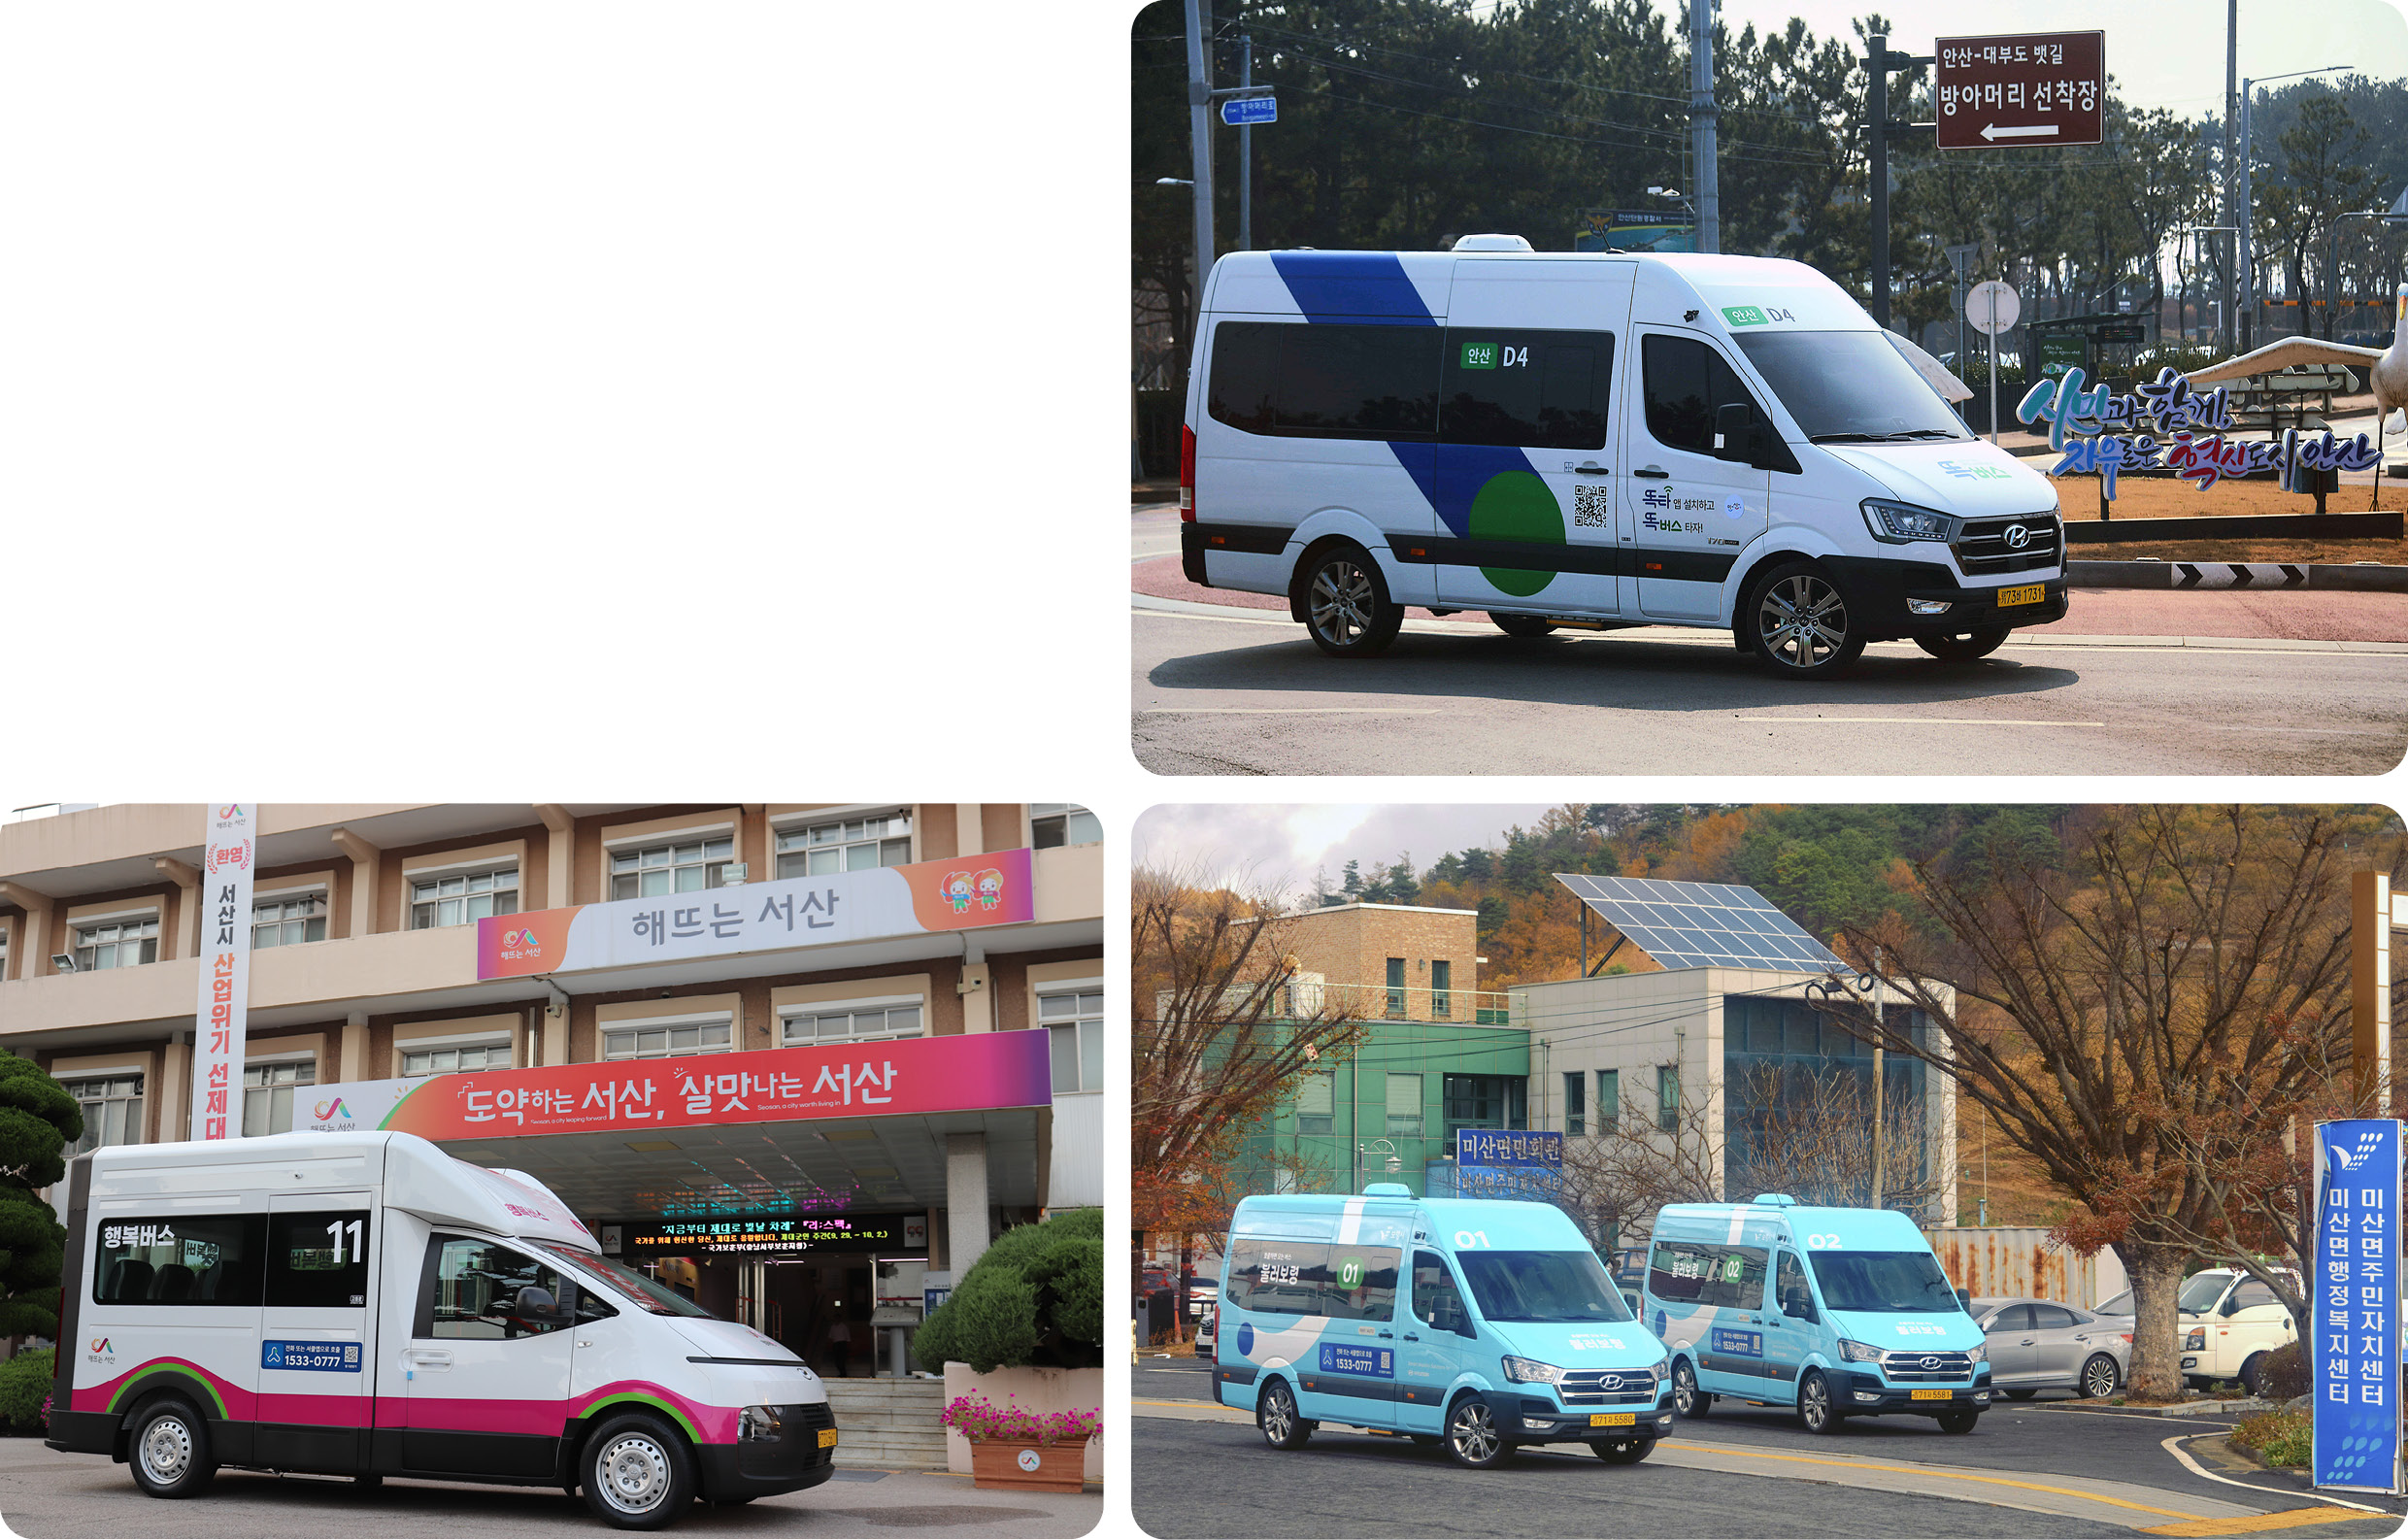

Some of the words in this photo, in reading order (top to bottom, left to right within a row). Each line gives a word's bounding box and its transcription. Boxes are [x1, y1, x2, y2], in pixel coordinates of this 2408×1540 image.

[1943, 46, 2028, 69] 안산-대부도
[2033, 44, 2063, 65] 뱃길
[1940, 82, 2026, 117] 방아머리
[2032, 80, 2098, 113] 선착장
[1732, 308, 1757, 323] 안산
[1766, 307, 1796, 322] D4
[1468, 347, 1491, 365] 안산
[1502, 346, 1528, 367] D4
[2048, 434, 2164, 501] 자유로운
[2162, 428, 2296, 491] 혁신도시
[2297, 431, 2383, 472] 안산
[1673, 499, 1682, 510] 앱
[1683, 498, 1716, 512] 설치하고
[1642, 512, 1683, 532] 똑버스
[1685, 521, 1703, 534] 타자!
[2023, 586, 2042, 602] 1731
[216, 846, 243, 865] 환영
[217, 884, 236, 945] 서산시
[632, 902, 745, 947] 해뜨는
[757, 888, 840, 932] 서산
[501, 950, 524, 960] 해뜨는
[525, 948, 541, 957] 서산
[210, 953, 235, 1055] 산업위기
[464, 1087, 575, 1126] 도약하는
[581, 1078, 665, 1121] 서산,
[678, 1070, 804, 1116] 살맛나는
[812, 1060, 898, 1106] 서산
[710, 1223, 741, 1235] 제대로
[104, 1224, 176, 1250] 행복버스
[326, 1220, 363, 1263] 11
[1455, 1230, 1491, 1249] 01
[1808, 1233, 1842, 1250] 02
[1260, 1262, 1300, 1285] 불러보령
[1342, 1262, 1358, 1284] 01
[1726, 1260, 1740, 1278] 02
[284, 1355, 341, 1367] 1533-0777
[1336, 1358, 1373, 1371] 1533-0777
[1614, 1415, 1633, 1424] 5580
